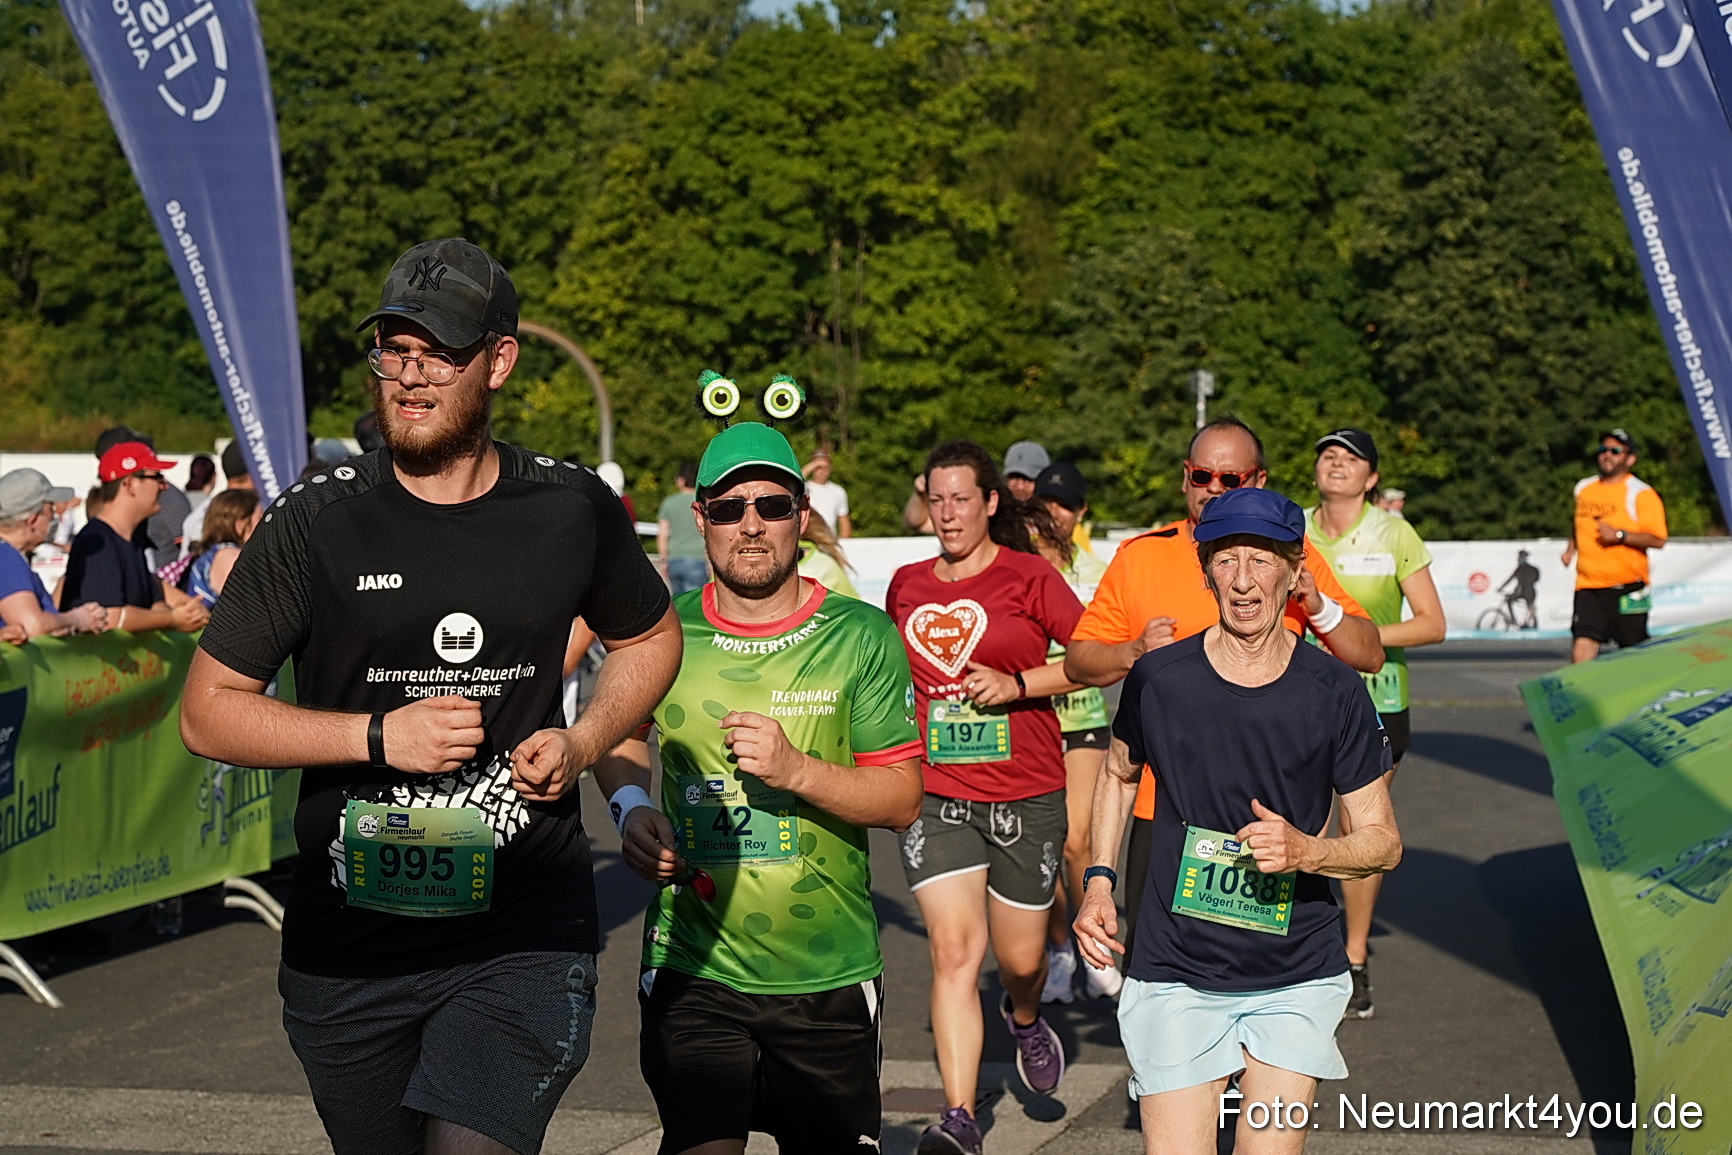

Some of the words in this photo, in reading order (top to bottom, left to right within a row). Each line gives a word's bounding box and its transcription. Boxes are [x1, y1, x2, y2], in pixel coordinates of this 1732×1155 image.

[356, 574, 403, 591] JAKO
[928, 626, 960, 640] Alexa
[405, 684, 502, 698] SCHOTTERWERKE
[770, 689, 840, 703] TRENDHAUS
[769, 704, 836, 717] POWER-TEAM
[946, 722, 987, 743] 197
[702, 790, 738, 799] Firmenlauf
[380, 827, 426, 835] Firmenlauf
[712, 806, 753, 836] 42
[778, 809, 791, 851] 2022
[685, 817, 695, 849] RUN
[703, 840, 741, 851] Richter
[744, 839, 768, 851] Roy
[1215, 849, 1252, 861] Firmenlauf
[353, 851, 366, 887] RUN
[378, 843, 455, 881] 995
[472, 852, 486, 900] 2022
[1182, 867, 1198, 898] RUN
[1201, 862, 1278, 903] 1088
[377, 880, 420, 897] Dörjes
[424, 885, 457, 897] Mika
[1198, 891, 1235, 908] Vögerl
[1237, 899, 1272, 916] Teresa
[1276, 881, 1290, 922] 2022
